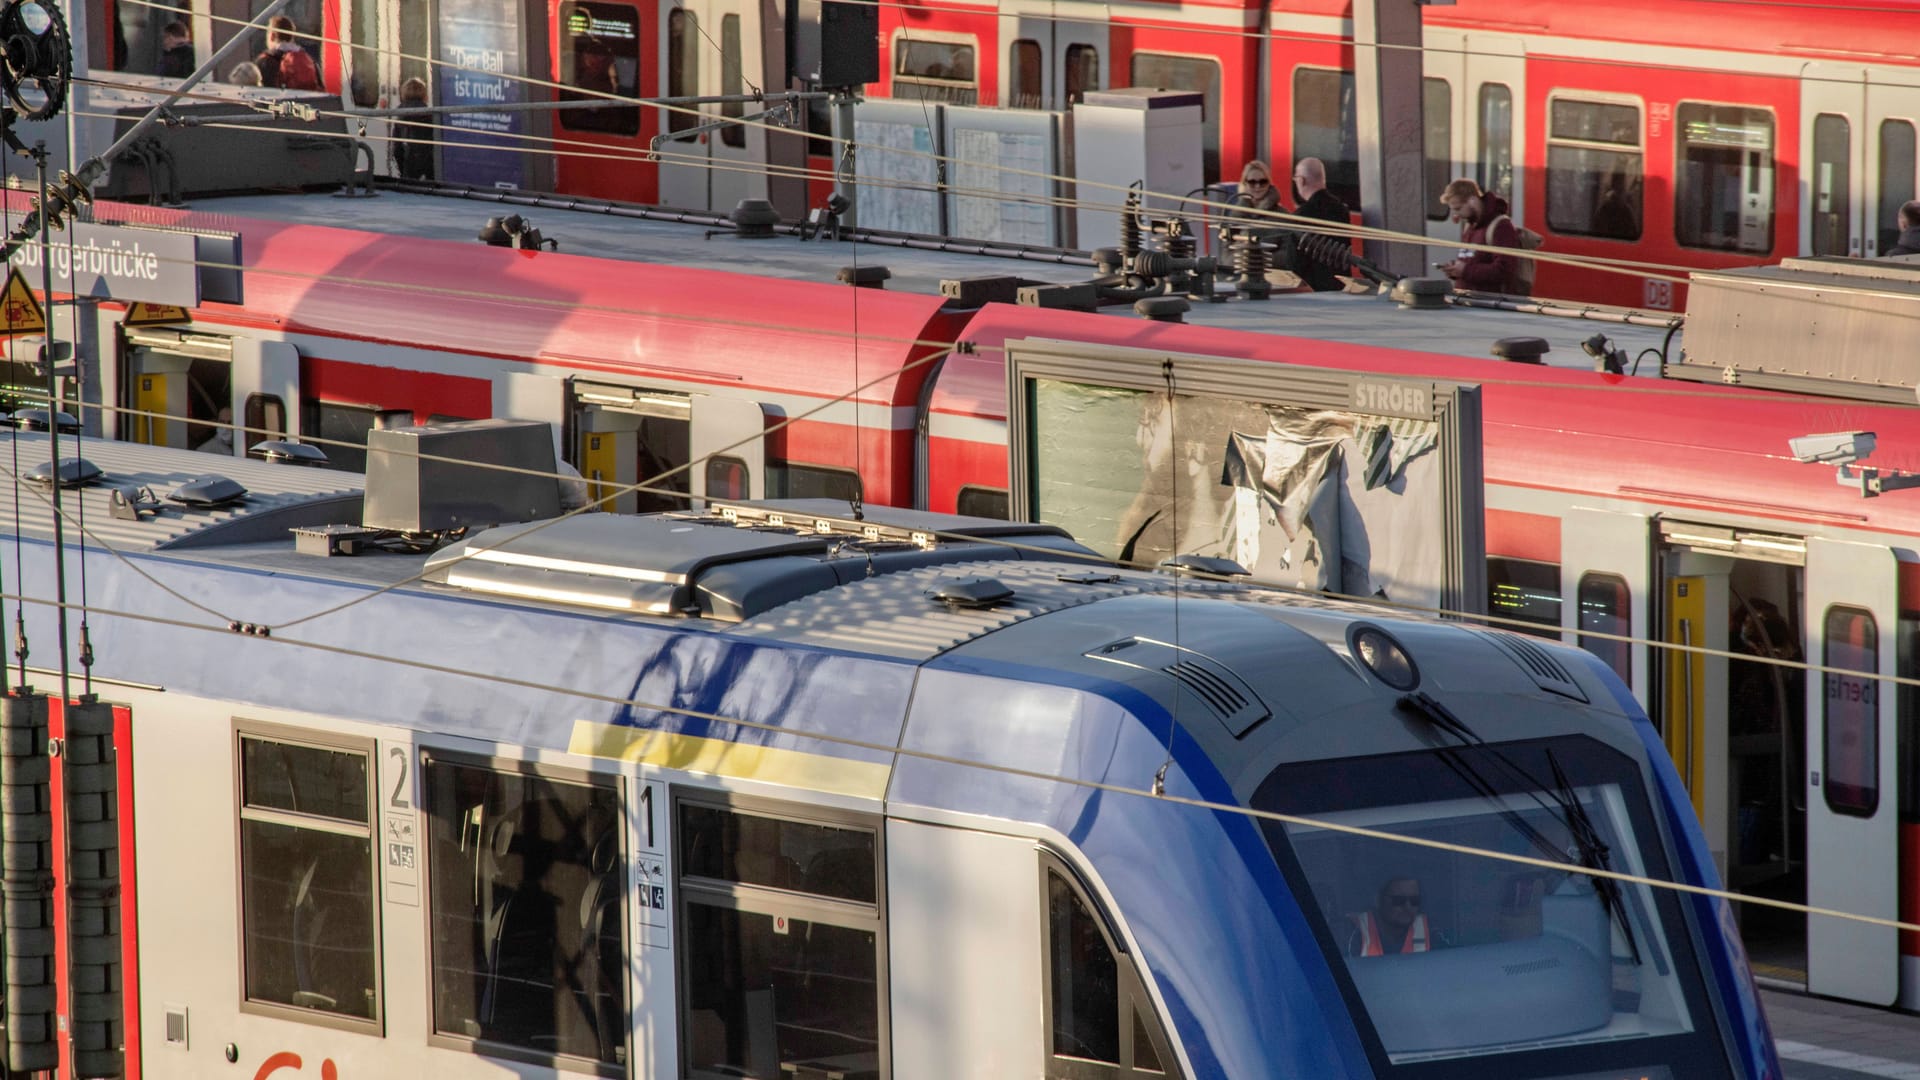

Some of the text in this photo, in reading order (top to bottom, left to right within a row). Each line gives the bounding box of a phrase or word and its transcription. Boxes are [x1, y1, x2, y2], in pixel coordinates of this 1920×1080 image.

[482, 50, 504, 73] Ball
[455, 74, 471, 97] ist
[12, 237, 158, 281] sbrgerbrücke
[1647, 279, 1671, 308] DB
[1355, 382, 1426, 415] STRÖER
[389, 747, 410, 809] 2
[639, 785, 655, 849] 1
